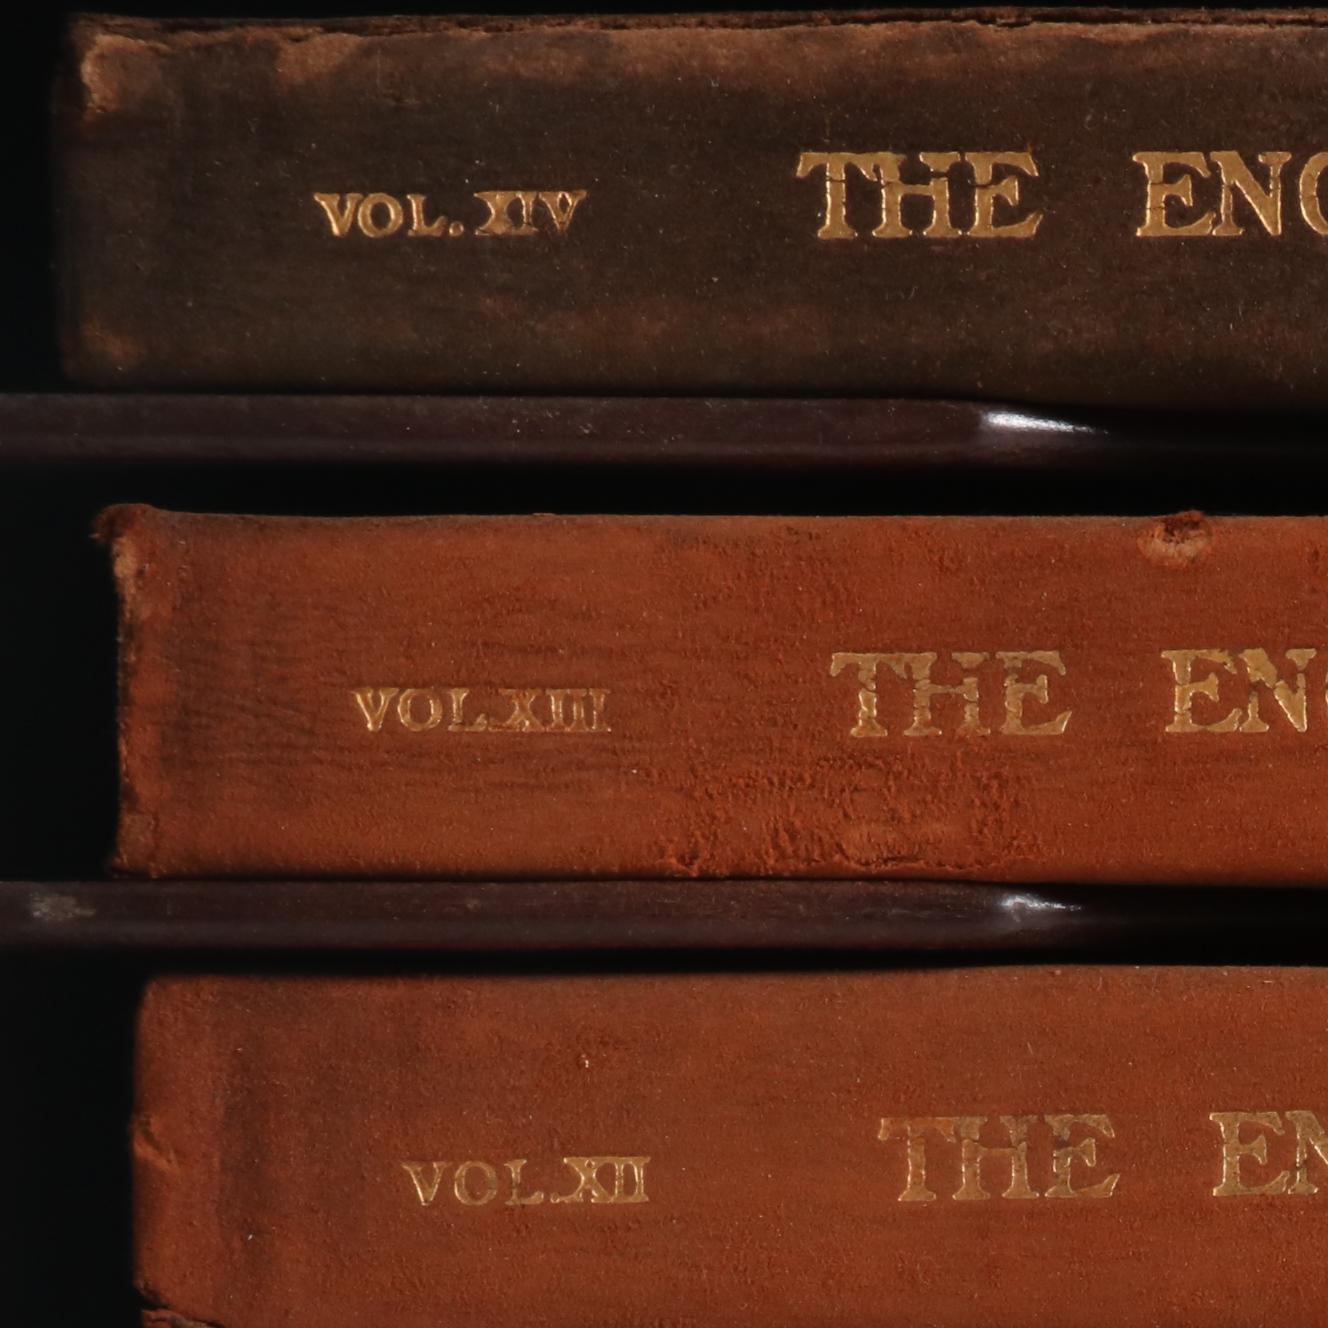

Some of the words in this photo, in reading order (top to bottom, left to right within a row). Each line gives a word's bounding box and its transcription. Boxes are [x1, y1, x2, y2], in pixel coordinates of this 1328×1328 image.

[796, 150, 1045, 240] THE
[829, 649, 1073, 738] THE
[877, 1113, 1122, 1203] THE
